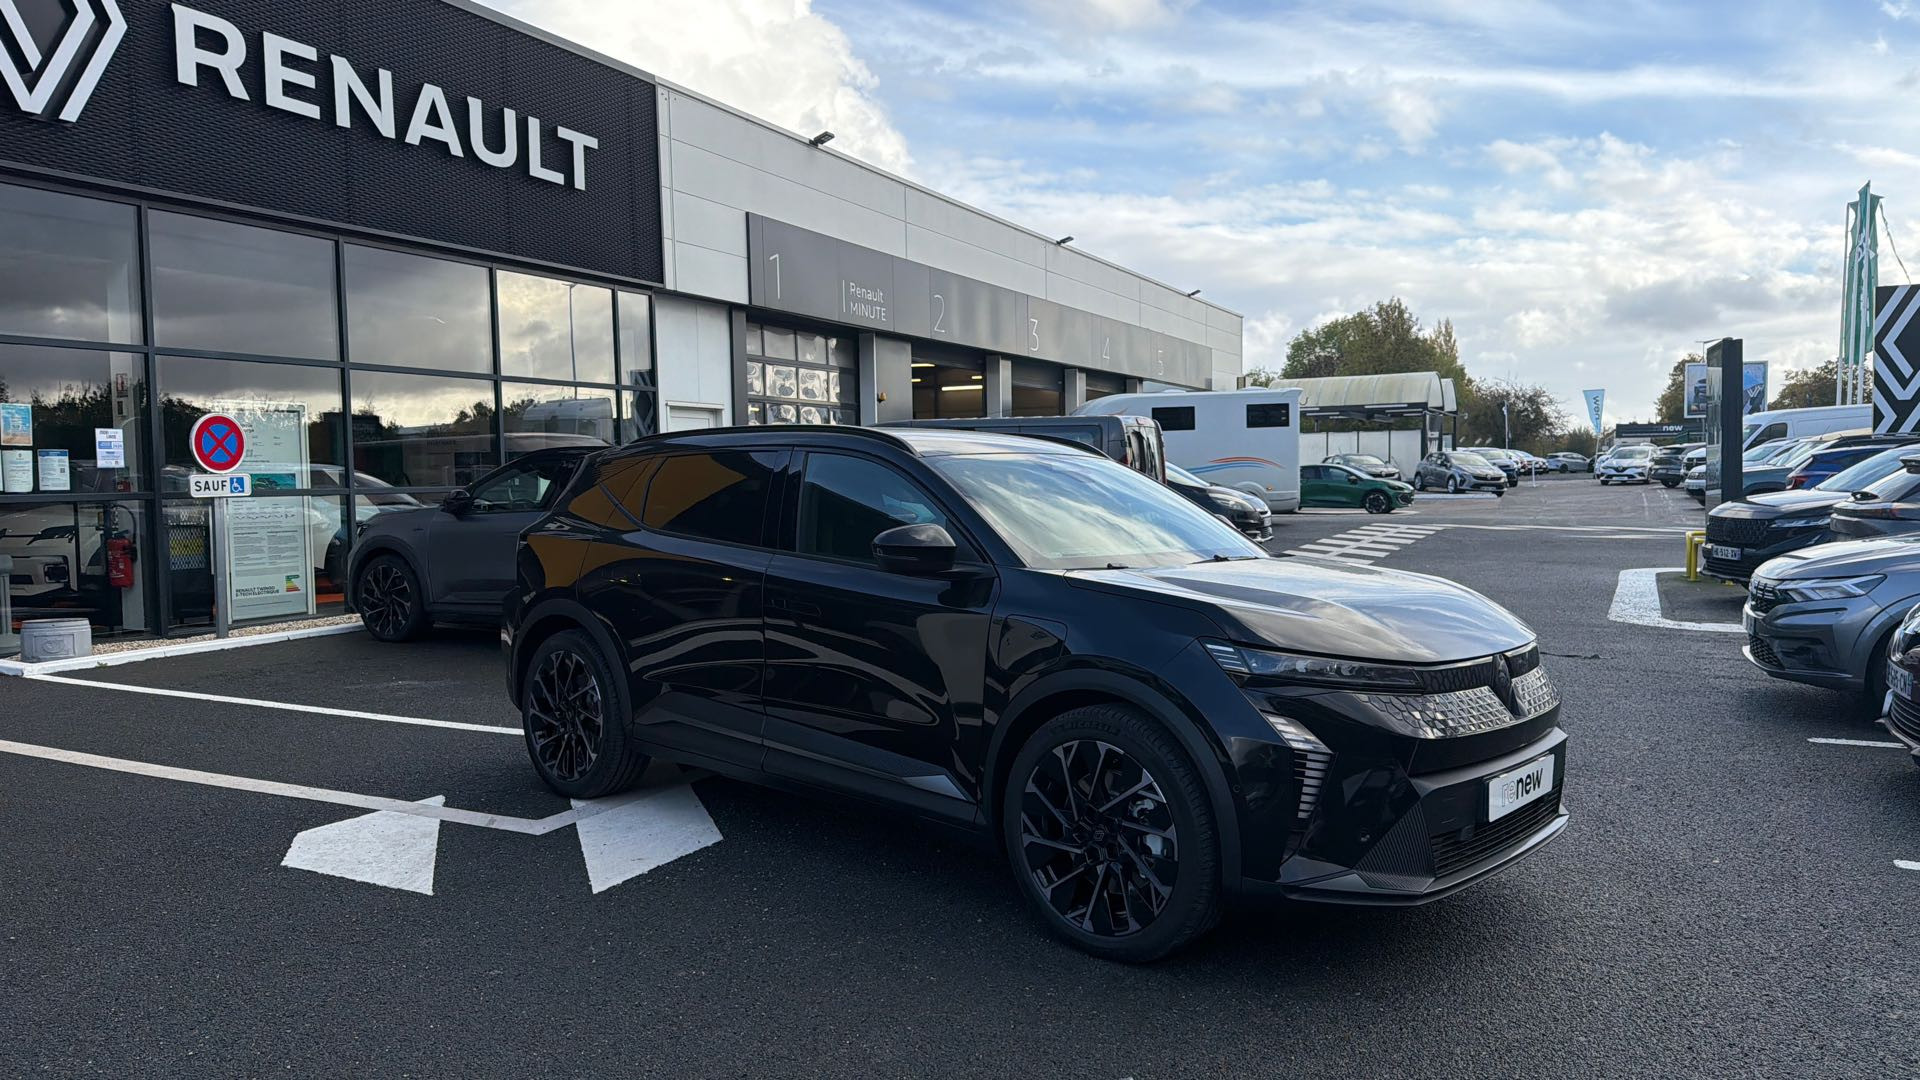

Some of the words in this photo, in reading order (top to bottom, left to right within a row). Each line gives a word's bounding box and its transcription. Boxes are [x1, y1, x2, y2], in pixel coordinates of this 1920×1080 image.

[170, 2, 599, 191] RENAULT
[769, 253, 781, 300] 1
[849, 281, 884, 303] Renault
[850, 301, 887, 321] MINUTE
[933, 294, 945, 333] 2
[1029, 318, 1039, 351] 3
[194, 480, 227, 492] SAUF
[1502, 768, 1543, 807] renew
